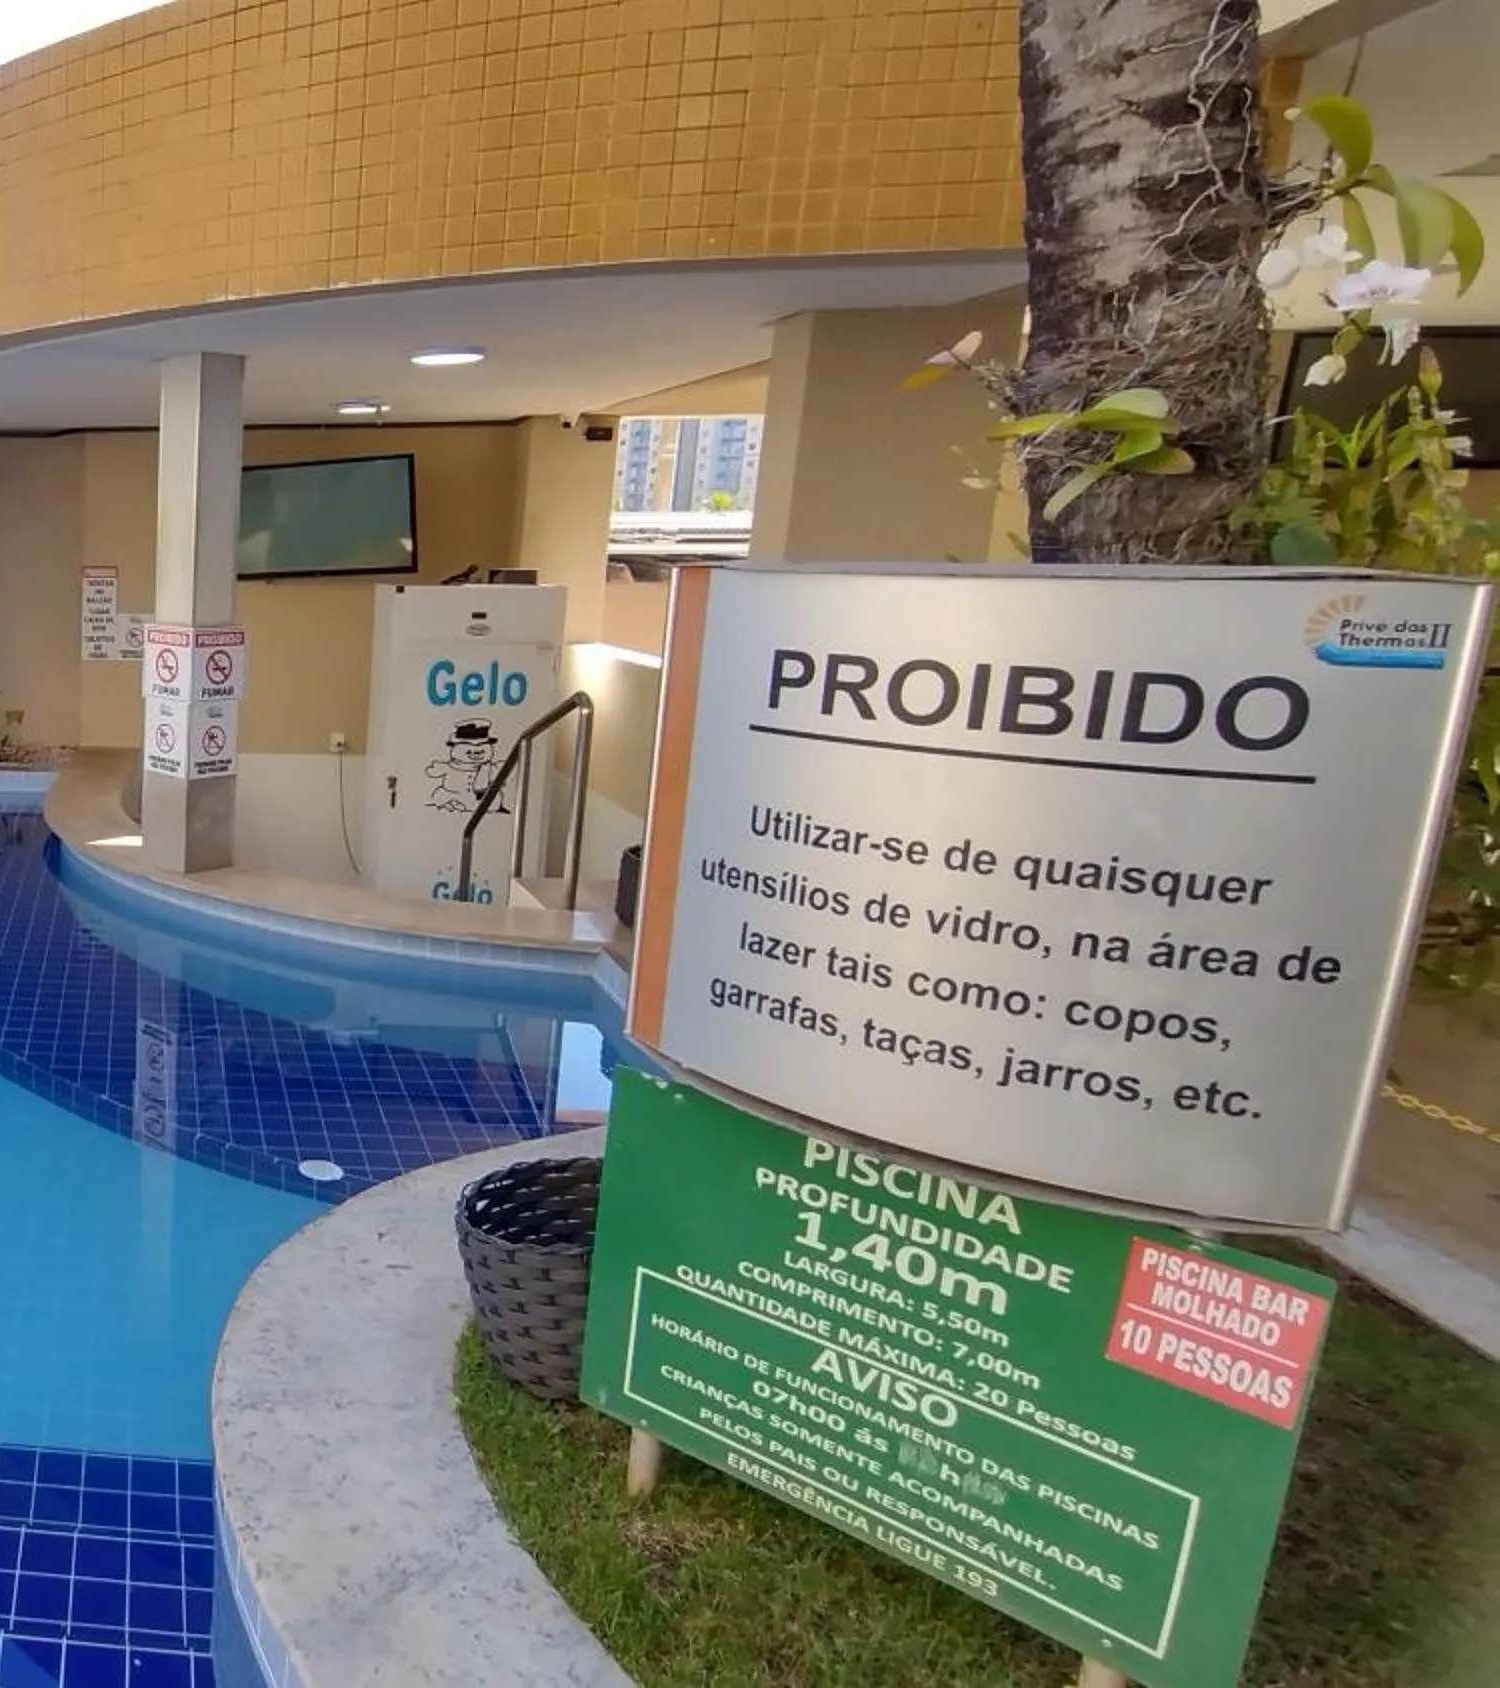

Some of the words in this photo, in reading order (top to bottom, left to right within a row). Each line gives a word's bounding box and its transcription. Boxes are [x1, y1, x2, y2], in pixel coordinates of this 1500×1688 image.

[427, 660, 528, 706] Gelo
[1428, 623, 1452, 648] II
[201, 686, 235, 698] FUMAR
[767, 649, 1310, 751] PROIBIDO
[432, 882, 493, 904] Glo
[750, 806, 929, 866] Utilizar-se
[943, 835, 997, 875] de
[1013, 851, 1273, 909] quaisquer
[700, 856, 850, 918] utensílios
[864, 892, 911, 929] de
[926, 908, 1052, 960] vidro,
[1071, 930, 1129, 965] na
[1147, 930, 1258, 978] área
[1277, 946, 1342, 985] de
[739, 922, 815, 970] lazer
[826, 946, 893, 990] tais
[907, 968, 1046, 1020] como:
[1064, 997, 1233, 1051] copos,
[710, 973, 848, 1045] garrafas,
[862, 1019, 984, 1080] taças,
[998, 1046, 1154, 1111] jarros,
[1173, 1081, 1263, 1120] etc.
[755, 1168, 1074, 1293] PROFUNDIDADE
[804, 1136, 1021, 1234] PISCINA
[784, 1251, 914, 1311] LARGURA:
[921, 1304, 1009, 1347] 5,50m
[795, 1211, 1007, 1315] 1,40m
[1141, 1248, 1243, 1304] PISCINA
[1252, 1285, 1309, 1327] BAR
[676, 1265, 831, 1337] QUANTIDADE
[838, 1328, 965, 1390] MÁXIMA:
[974, 1382, 1008, 1407] 20
[1016, 1399, 1136, 1460] Pessoas
[738, 1262, 943, 1350] COMPRIMENTO:
[952, 1341, 1041, 1390] 7,00m
[1120, 1320, 1151, 1354] 10
[1157, 1332, 1293, 1409] PESSOAS
[1151, 1283, 1280, 1346] MOLHADO
[651, 1314, 738, 1360] HORÁRIO
[744, 1354, 770, 1374] DE
[775, 1367, 974, 1464] FUNCIONAMENTO
[981, 1459, 1031, 1491] DAS
[1037, 1484, 1159, 1549] PISCINAS
[753, 1380, 846, 1433] 07h00
[812, 1350, 957, 1427] AVISO
[660, 1365, 763, 1420] CRIANÇAS
[769, 1414, 882, 1476] SOMENTE
[888, 1471, 1124, 1591] ACOMPANHADAS
[700, 1407, 763, 1447] PELOS
[769, 1440, 816, 1471] PAIS
[823, 1467, 859, 1492] OU
[866, 1486, 1056, 1590] RESPONSÁVEL.
[727, 1452, 869, 1533] EMERGÊNCIA
[876, 1526, 946, 1570] LIGUE
[954, 1565, 998, 1598] 193
